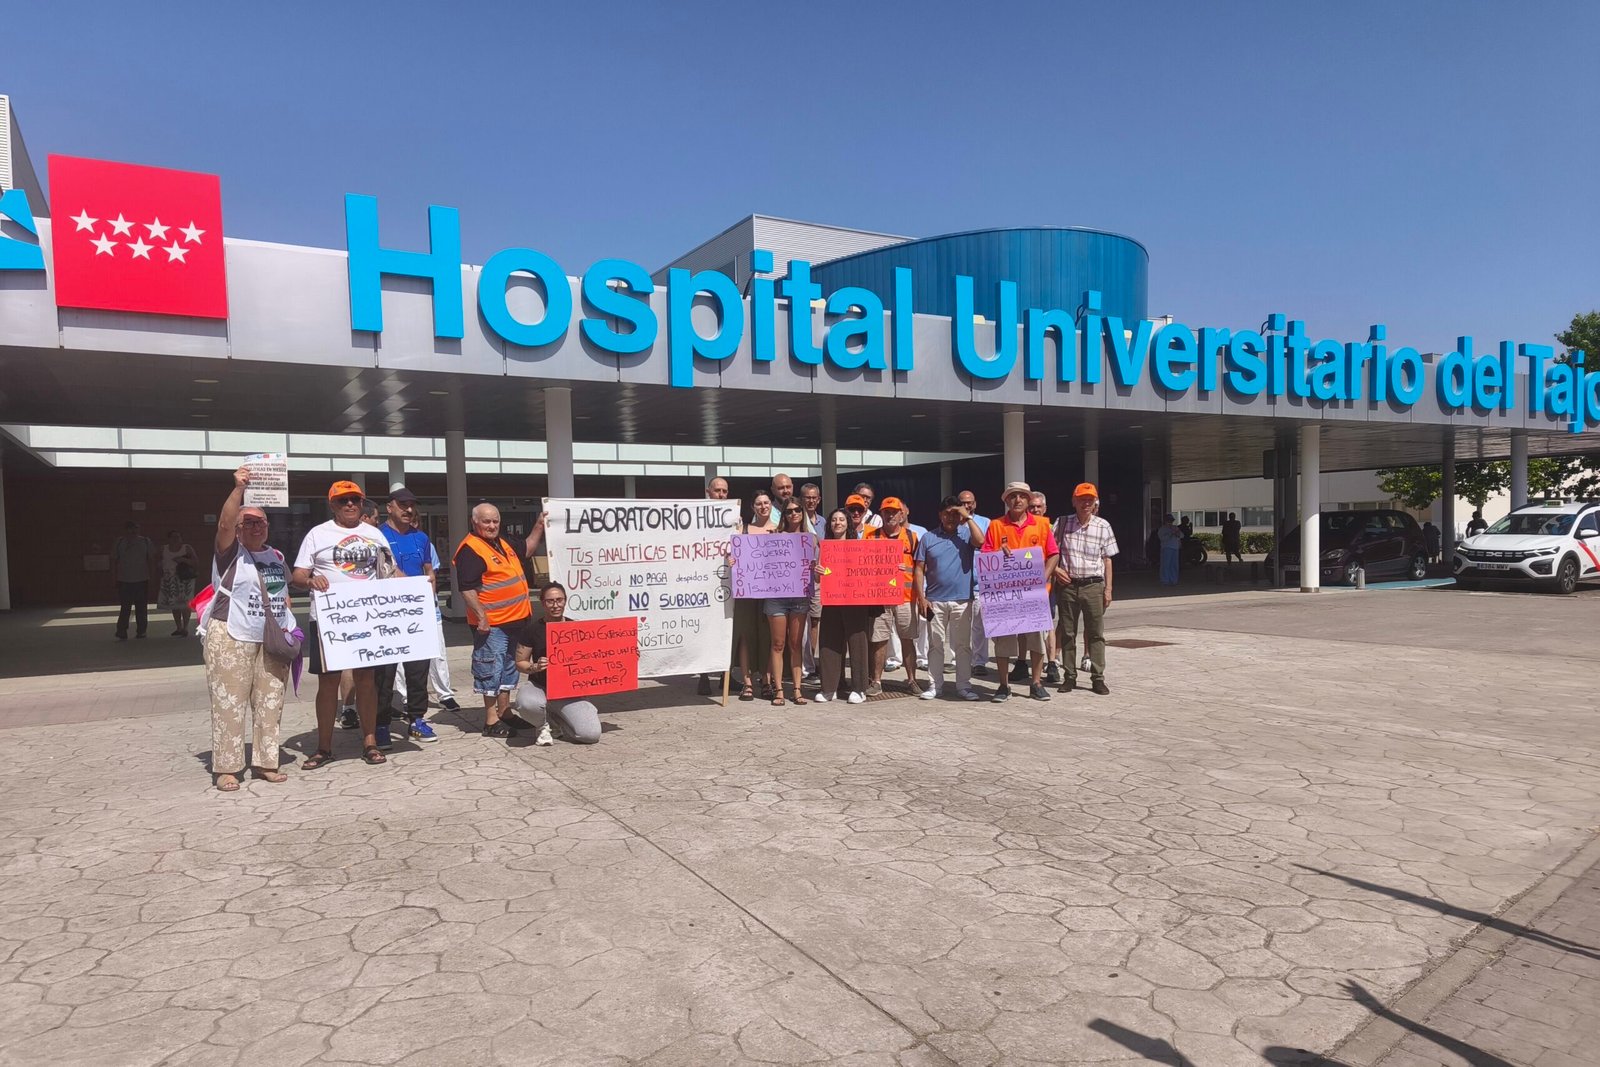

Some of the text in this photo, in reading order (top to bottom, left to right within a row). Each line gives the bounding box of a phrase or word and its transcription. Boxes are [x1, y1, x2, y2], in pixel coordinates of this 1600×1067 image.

[345, 193, 914, 388] Hospital
[952, 274, 1425, 406] Universitario
[1436, 336, 1515, 410] del
[565, 504, 733, 534] LABORATORIO HUIC
[672, 545, 691, 560] EN
[750, 548, 791, 559] GUERRA
[746, 561, 797, 573] NUESTRO
[978, 555, 1000, 573] NO
[1003, 560, 1033, 572] SOLO
[567, 569, 592, 590] UR
[594, 576, 622, 588] Salud
[630, 574, 644, 585] NO
[646, 572, 668, 583] PAGA
[676, 571, 709, 584] despidos
[993, 570, 1042, 581] LABORATORIO
[993, 578, 1043, 590] URGENCIAS
[319, 592, 425, 612] INCERTIDUMBRE
[567, 592, 710, 612] Quirón NO SUBROGA
[326, 607, 423, 625] PARA NOSOTROS
[373, 624, 401, 637] PARA
[407, 622, 424, 634] EL
[662, 620, 677, 630] no
[681, 615, 700, 634] hay
[551, 629, 595, 645] DESPIDEN
[637, 632, 684, 647] NÓSTICO
